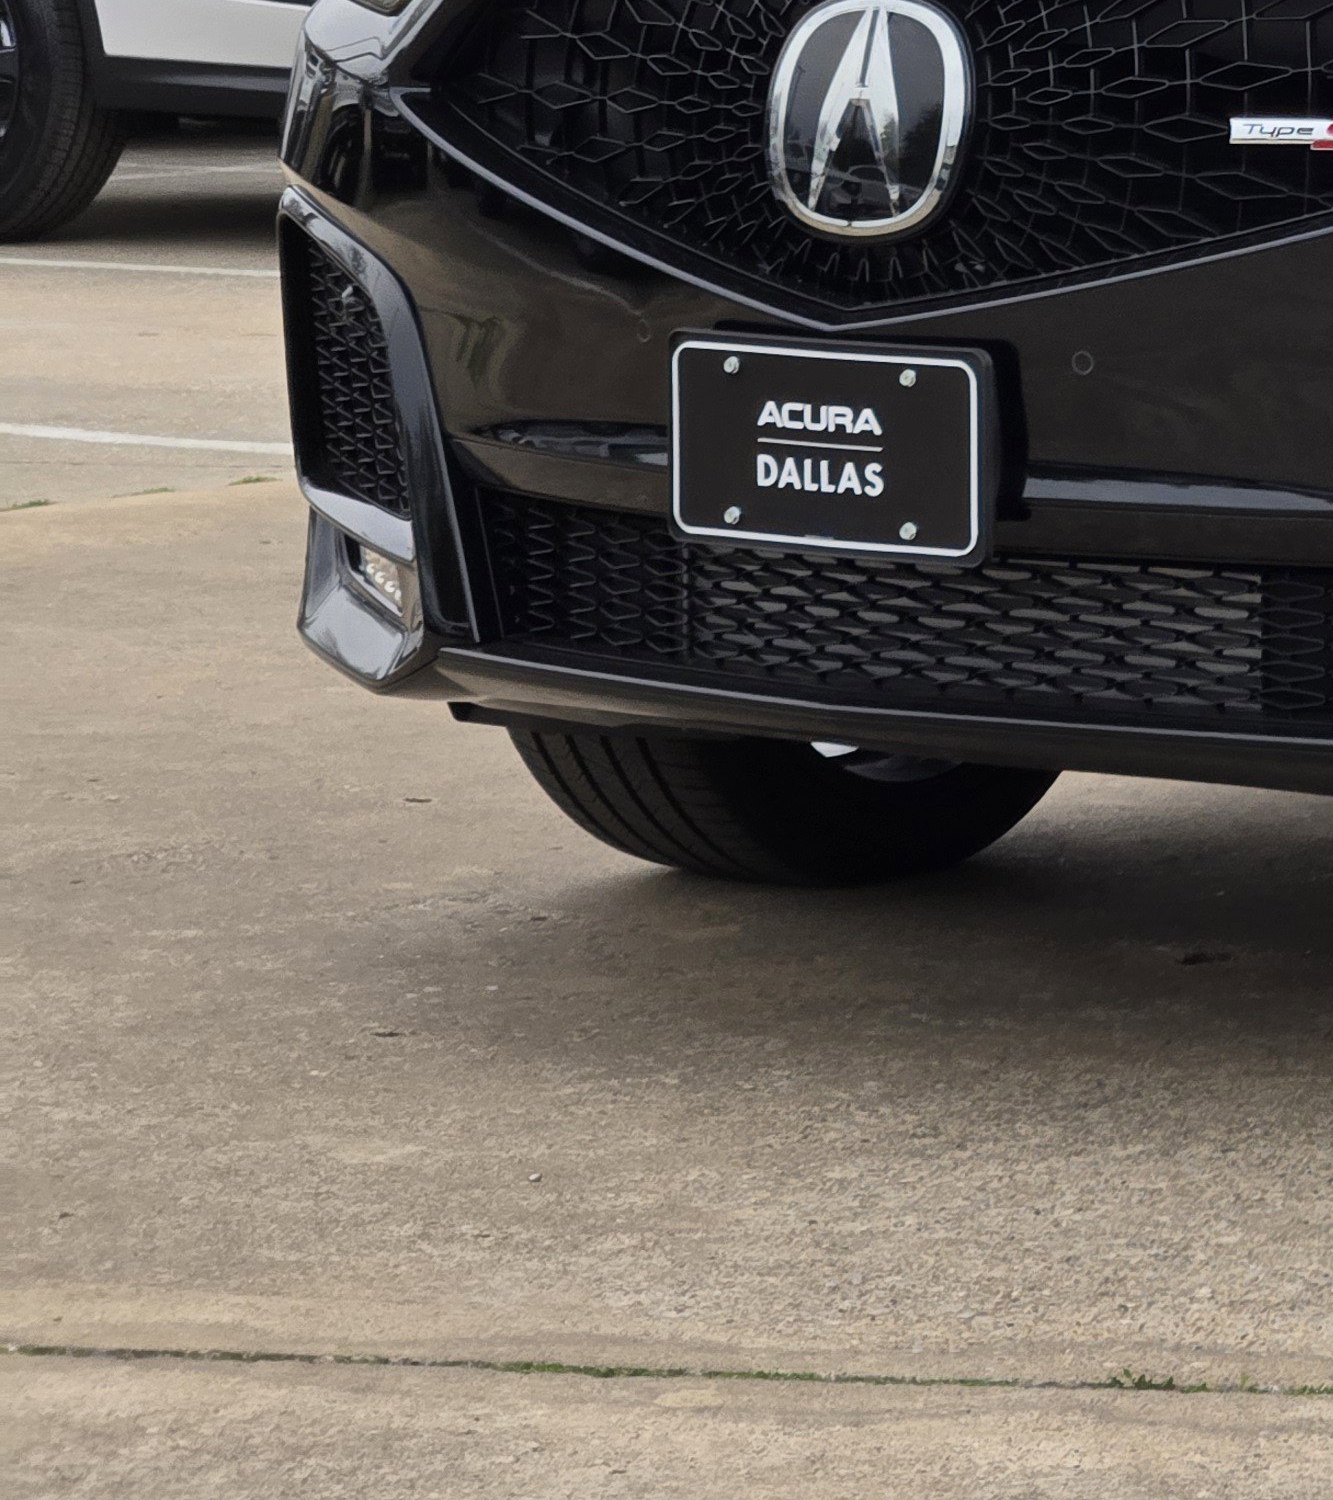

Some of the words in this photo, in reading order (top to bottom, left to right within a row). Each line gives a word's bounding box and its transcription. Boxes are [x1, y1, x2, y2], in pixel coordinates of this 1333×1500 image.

[1242, 122, 1314, 138] Type
[757, 401, 883, 436] ACURA
[757, 454, 885, 498] DALLAS
